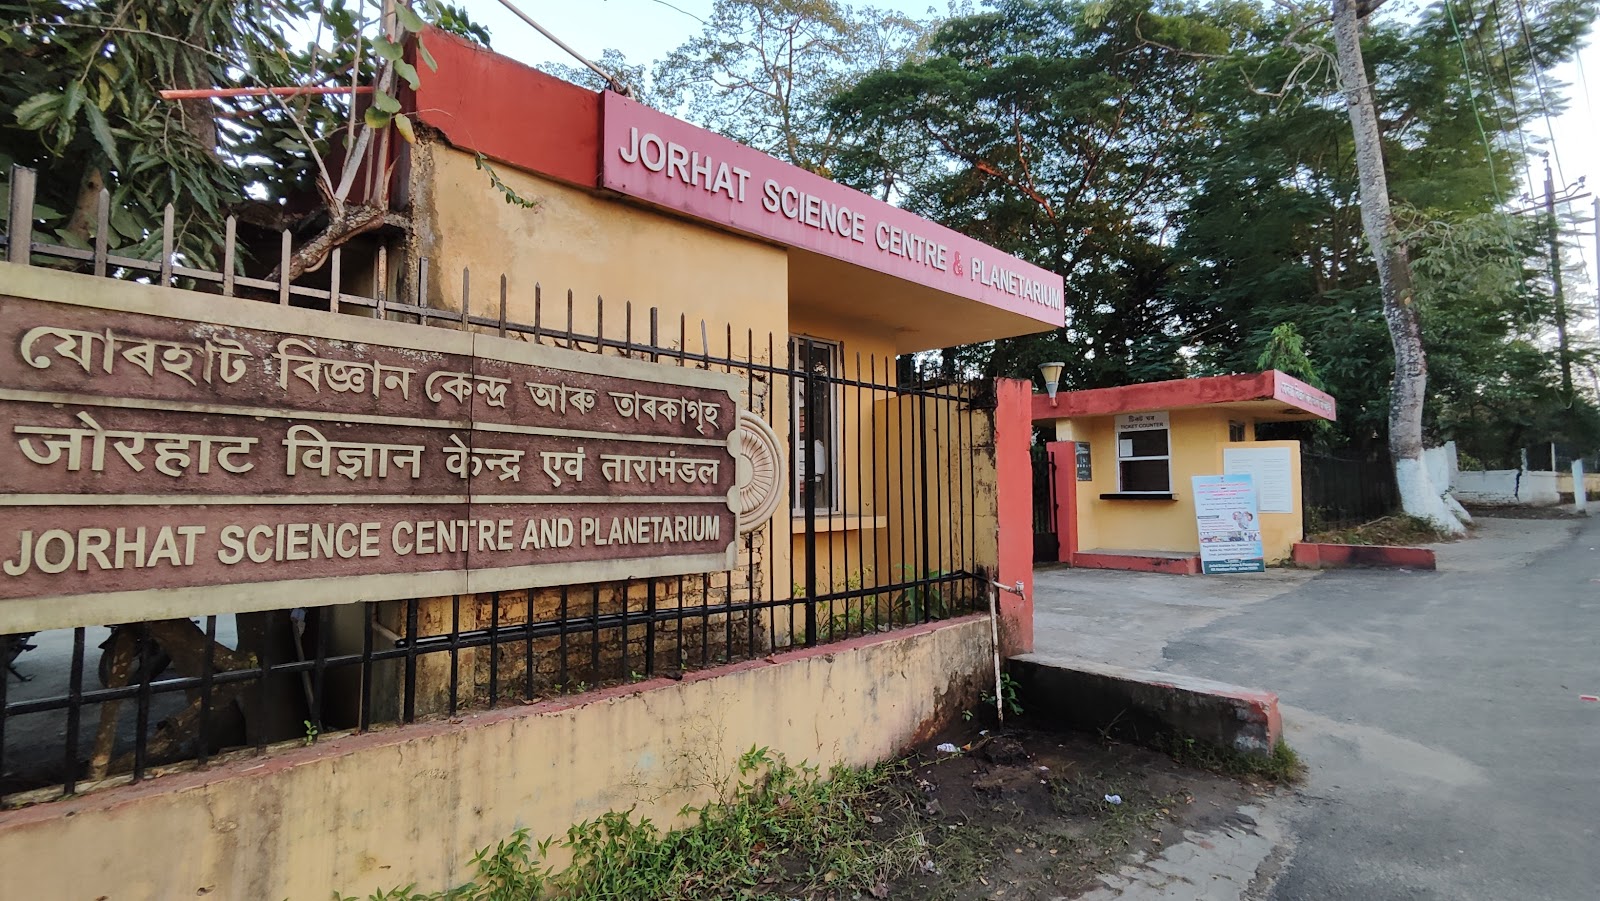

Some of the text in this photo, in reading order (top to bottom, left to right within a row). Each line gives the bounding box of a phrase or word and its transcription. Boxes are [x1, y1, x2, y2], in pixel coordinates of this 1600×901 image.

[619, 127, 1061, 310] JORHAT SCIENCE CENTRE & PLANETARIUM
[20, 326, 254, 386] যোৰহাট
[272, 337, 417, 401] বিজ্ঞান
[525, 382, 599, 415] আৰু
[608, 390, 720, 434] তাৰকাগৃহ
[14, 411, 720, 487] जोरहाट विज्ञान केन्द्र एवं तारामंडल
[3, 515, 720, 576] JORHAT SCIENCE CENTRE AND PLANETARIUM
